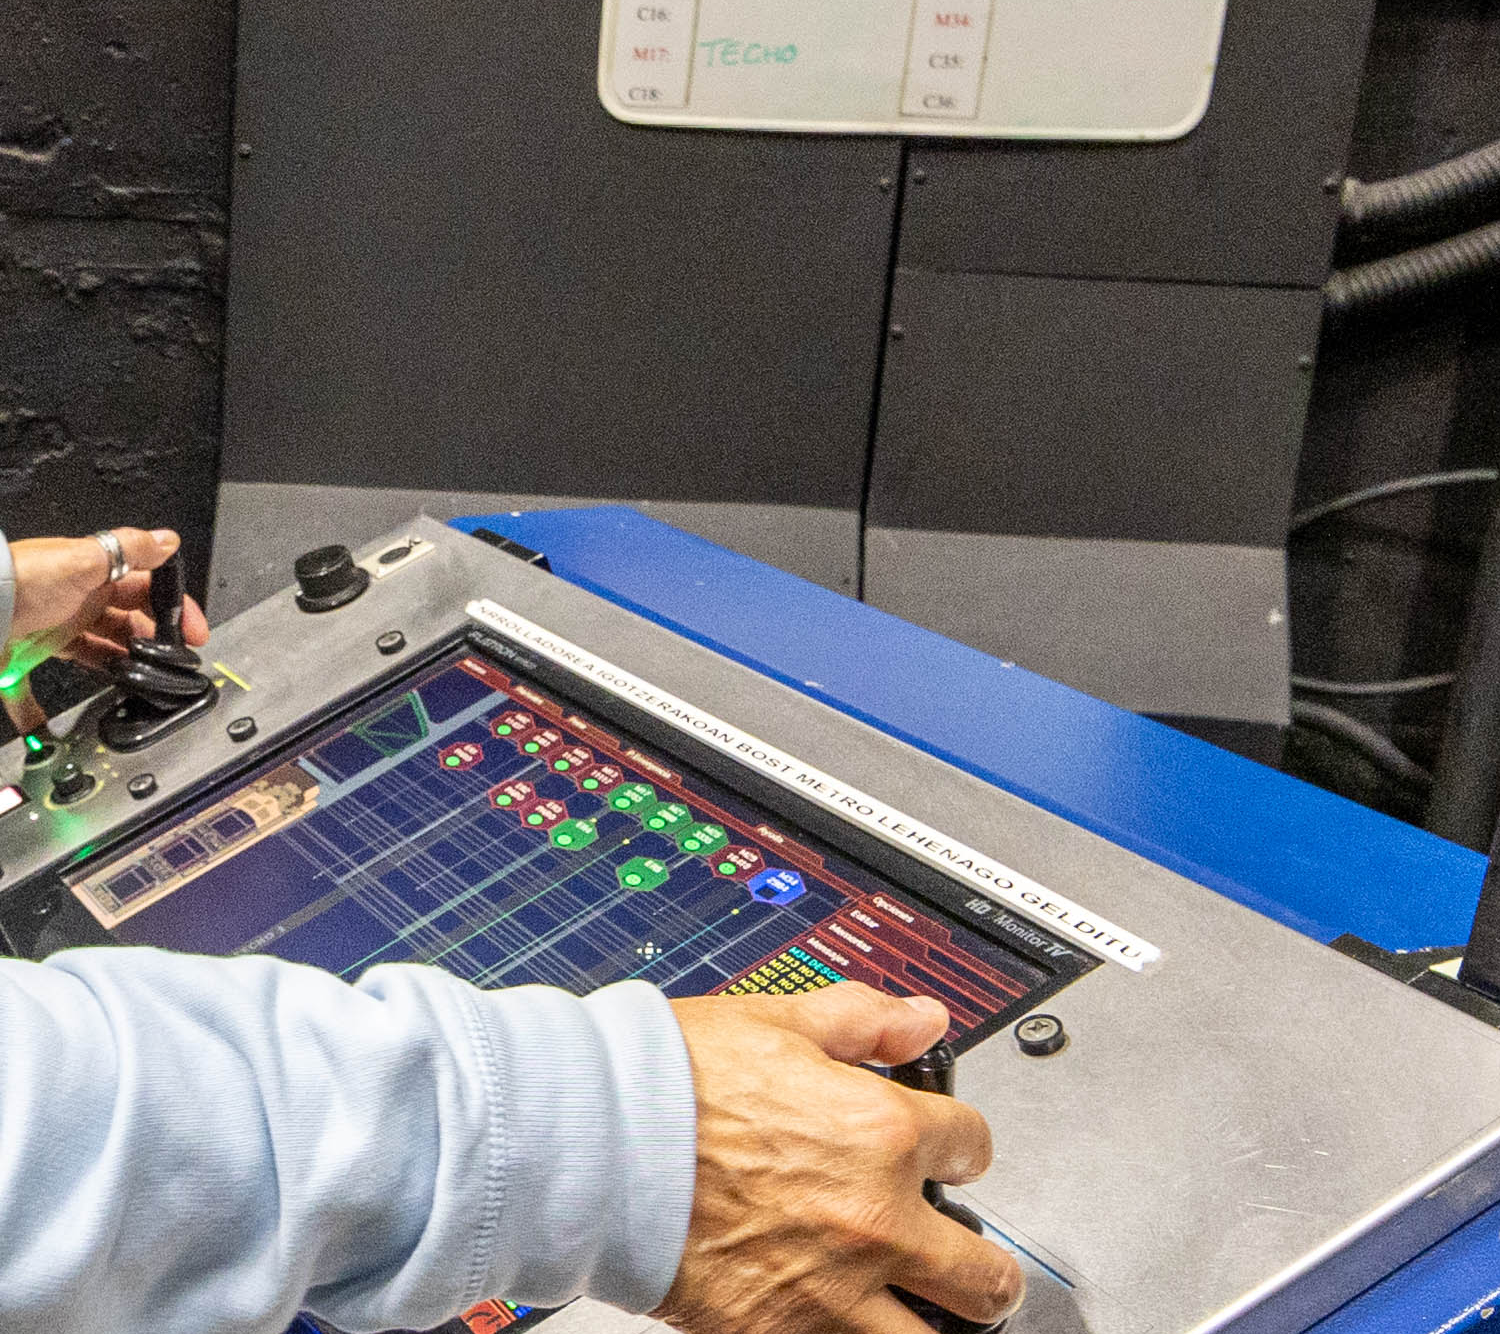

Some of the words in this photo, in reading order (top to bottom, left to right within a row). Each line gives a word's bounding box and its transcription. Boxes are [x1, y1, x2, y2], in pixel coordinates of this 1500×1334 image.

[596, 669, 736, 745] IGOTZERAKOAN
[735, 742, 795, 773] BOST
[795, 771, 875, 816] METRO
[878, 815, 1015, 890] LEHENAGO
[1019, 892, 1143, 960] GELDITU
[873, 897, 914, 923] Opciones
[994, 910, 1048, 955] Monitor
[1043, 941, 1077, 958] TV
[779, 953, 800, 968] M13
[798, 965, 815, 978] NO
[789, 947, 811, 962] M34
[769, 959, 790, 973] M17
[788, 971, 805, 984] NO
[778, 978, 795, 990] NO
